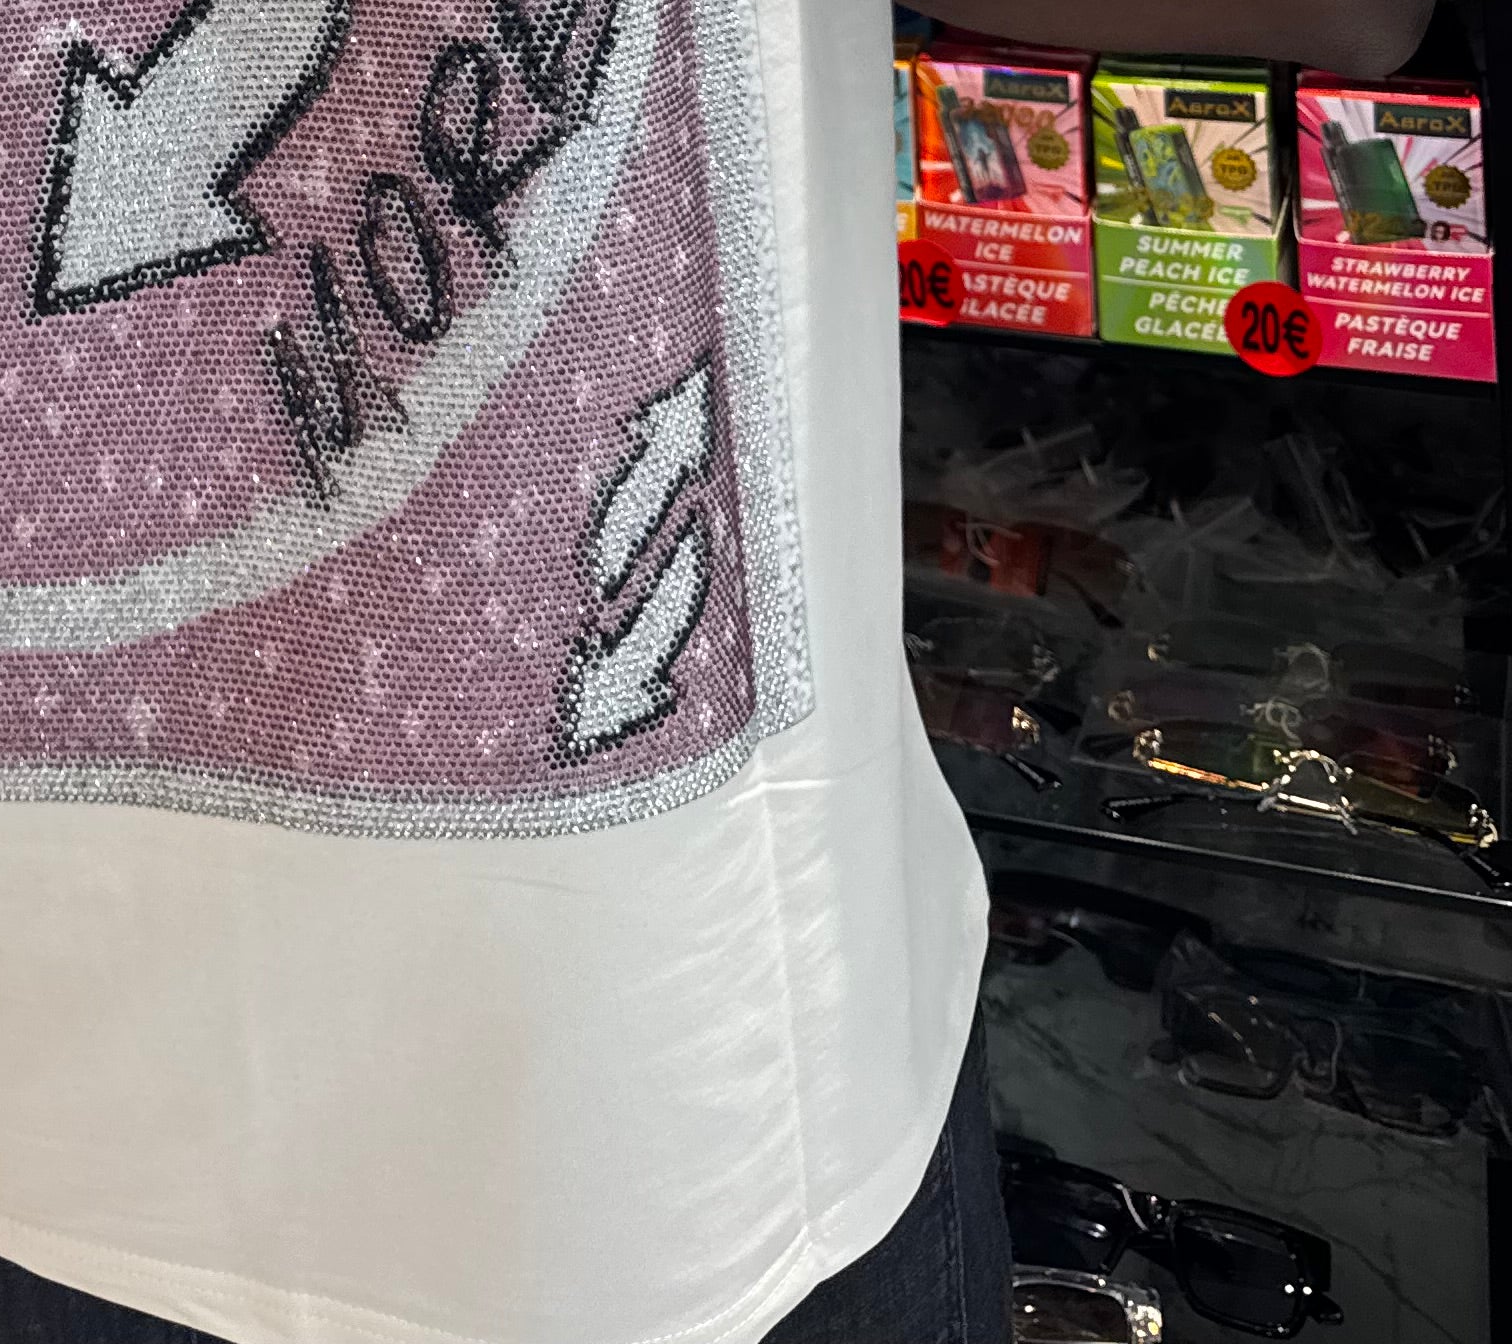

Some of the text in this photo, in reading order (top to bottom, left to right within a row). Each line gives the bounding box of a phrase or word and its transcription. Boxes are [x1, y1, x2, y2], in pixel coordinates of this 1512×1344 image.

[924, 212, 1084, 245] WATERMELON
[974, 239, 1015, 263] ICE
[1137, 234, 1244, 261] SUMMER
[1119, 256, 1251, 285] PEACH ICE
[1331, 256, 1471, 282] STRAWBERRY
[1306, 272, 1486, 304] WATERMELON ICE
[961, 298, 1048, 324] LACÉE
[1241, 300, 1311, 359] 20€
[1335, 312, 1463, 340] PASTÈQUE
[1347, 337, 1435, 362] FRAISE
